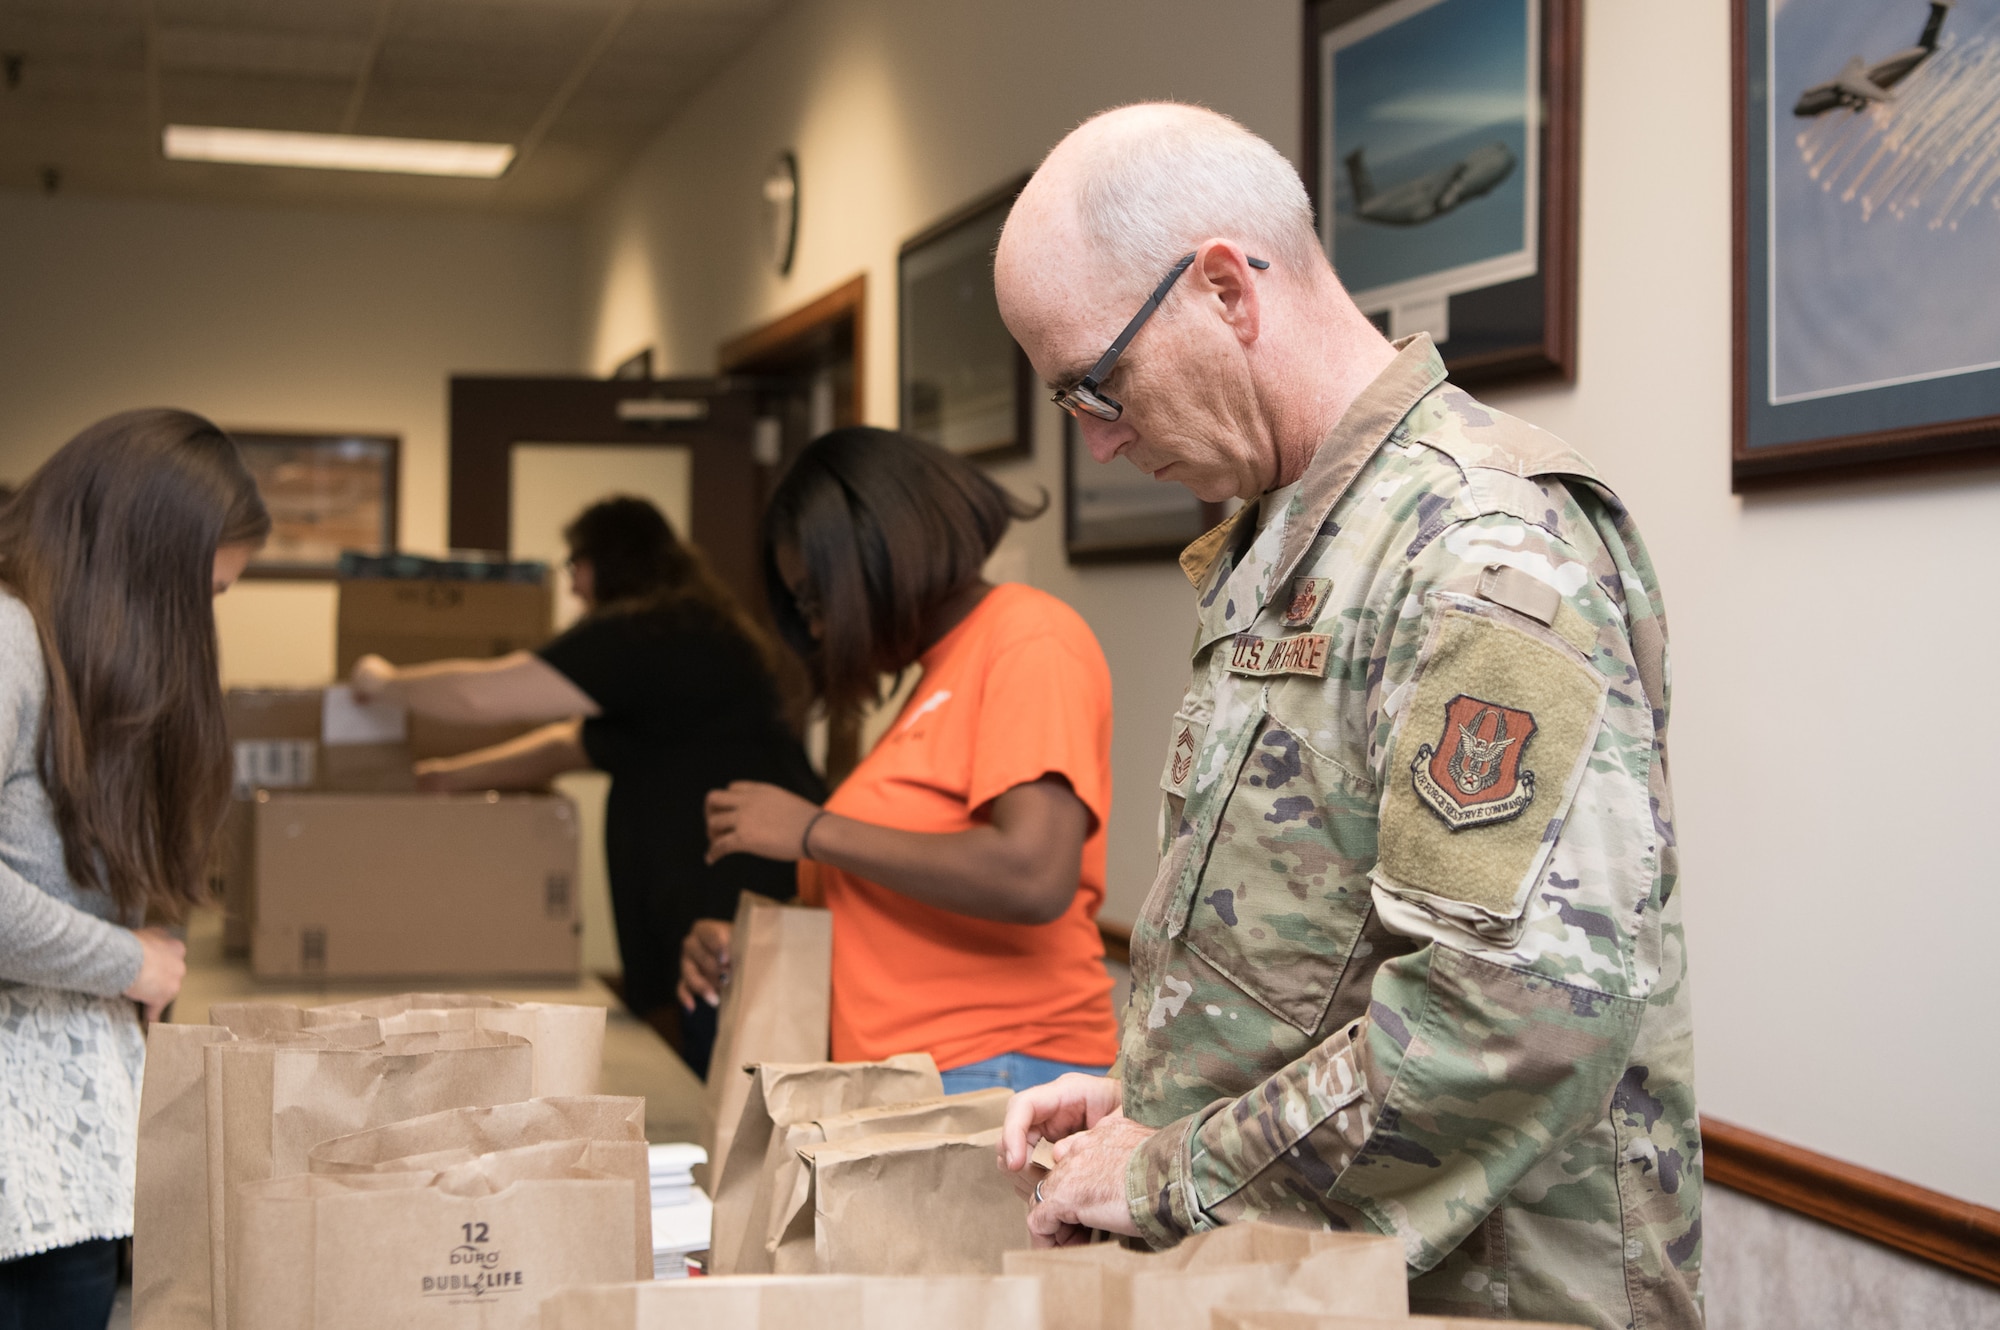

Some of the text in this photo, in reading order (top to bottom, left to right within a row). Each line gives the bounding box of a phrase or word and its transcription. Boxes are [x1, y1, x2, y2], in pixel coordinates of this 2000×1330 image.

[1232, 638, 1264, 670] U.S.
[1423, 782, 1446, 809] FORCE
[1444, 802, 1484, 821] RESERVE
[461, 1222, 490, 1243] 12
[449, 1249, 500, 1266] DURO
[487, 1271, 523, 1288] LIFE
